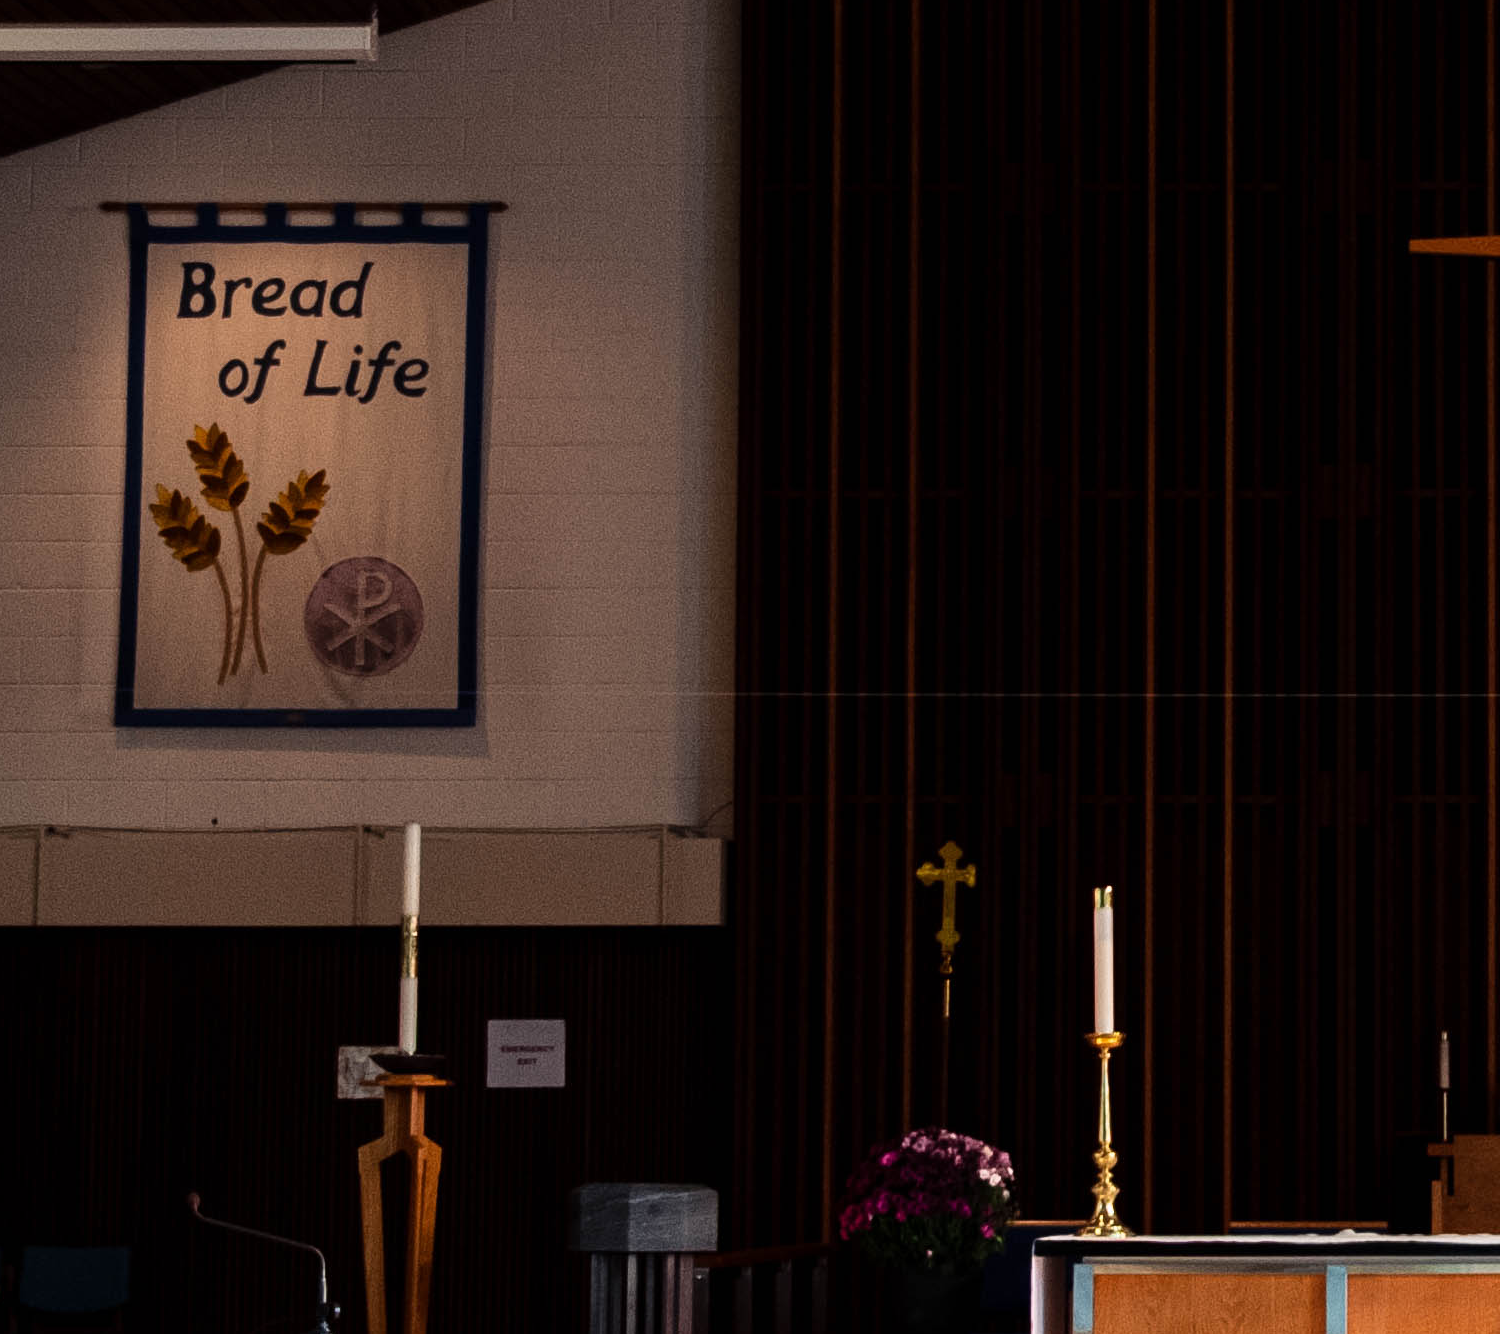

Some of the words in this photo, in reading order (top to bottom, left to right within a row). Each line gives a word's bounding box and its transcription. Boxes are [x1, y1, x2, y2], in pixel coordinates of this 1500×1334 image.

[177, 262, 374, 319] Bread
[218, 339, 287, 404] of
[303, 339, 430, 404] Life
